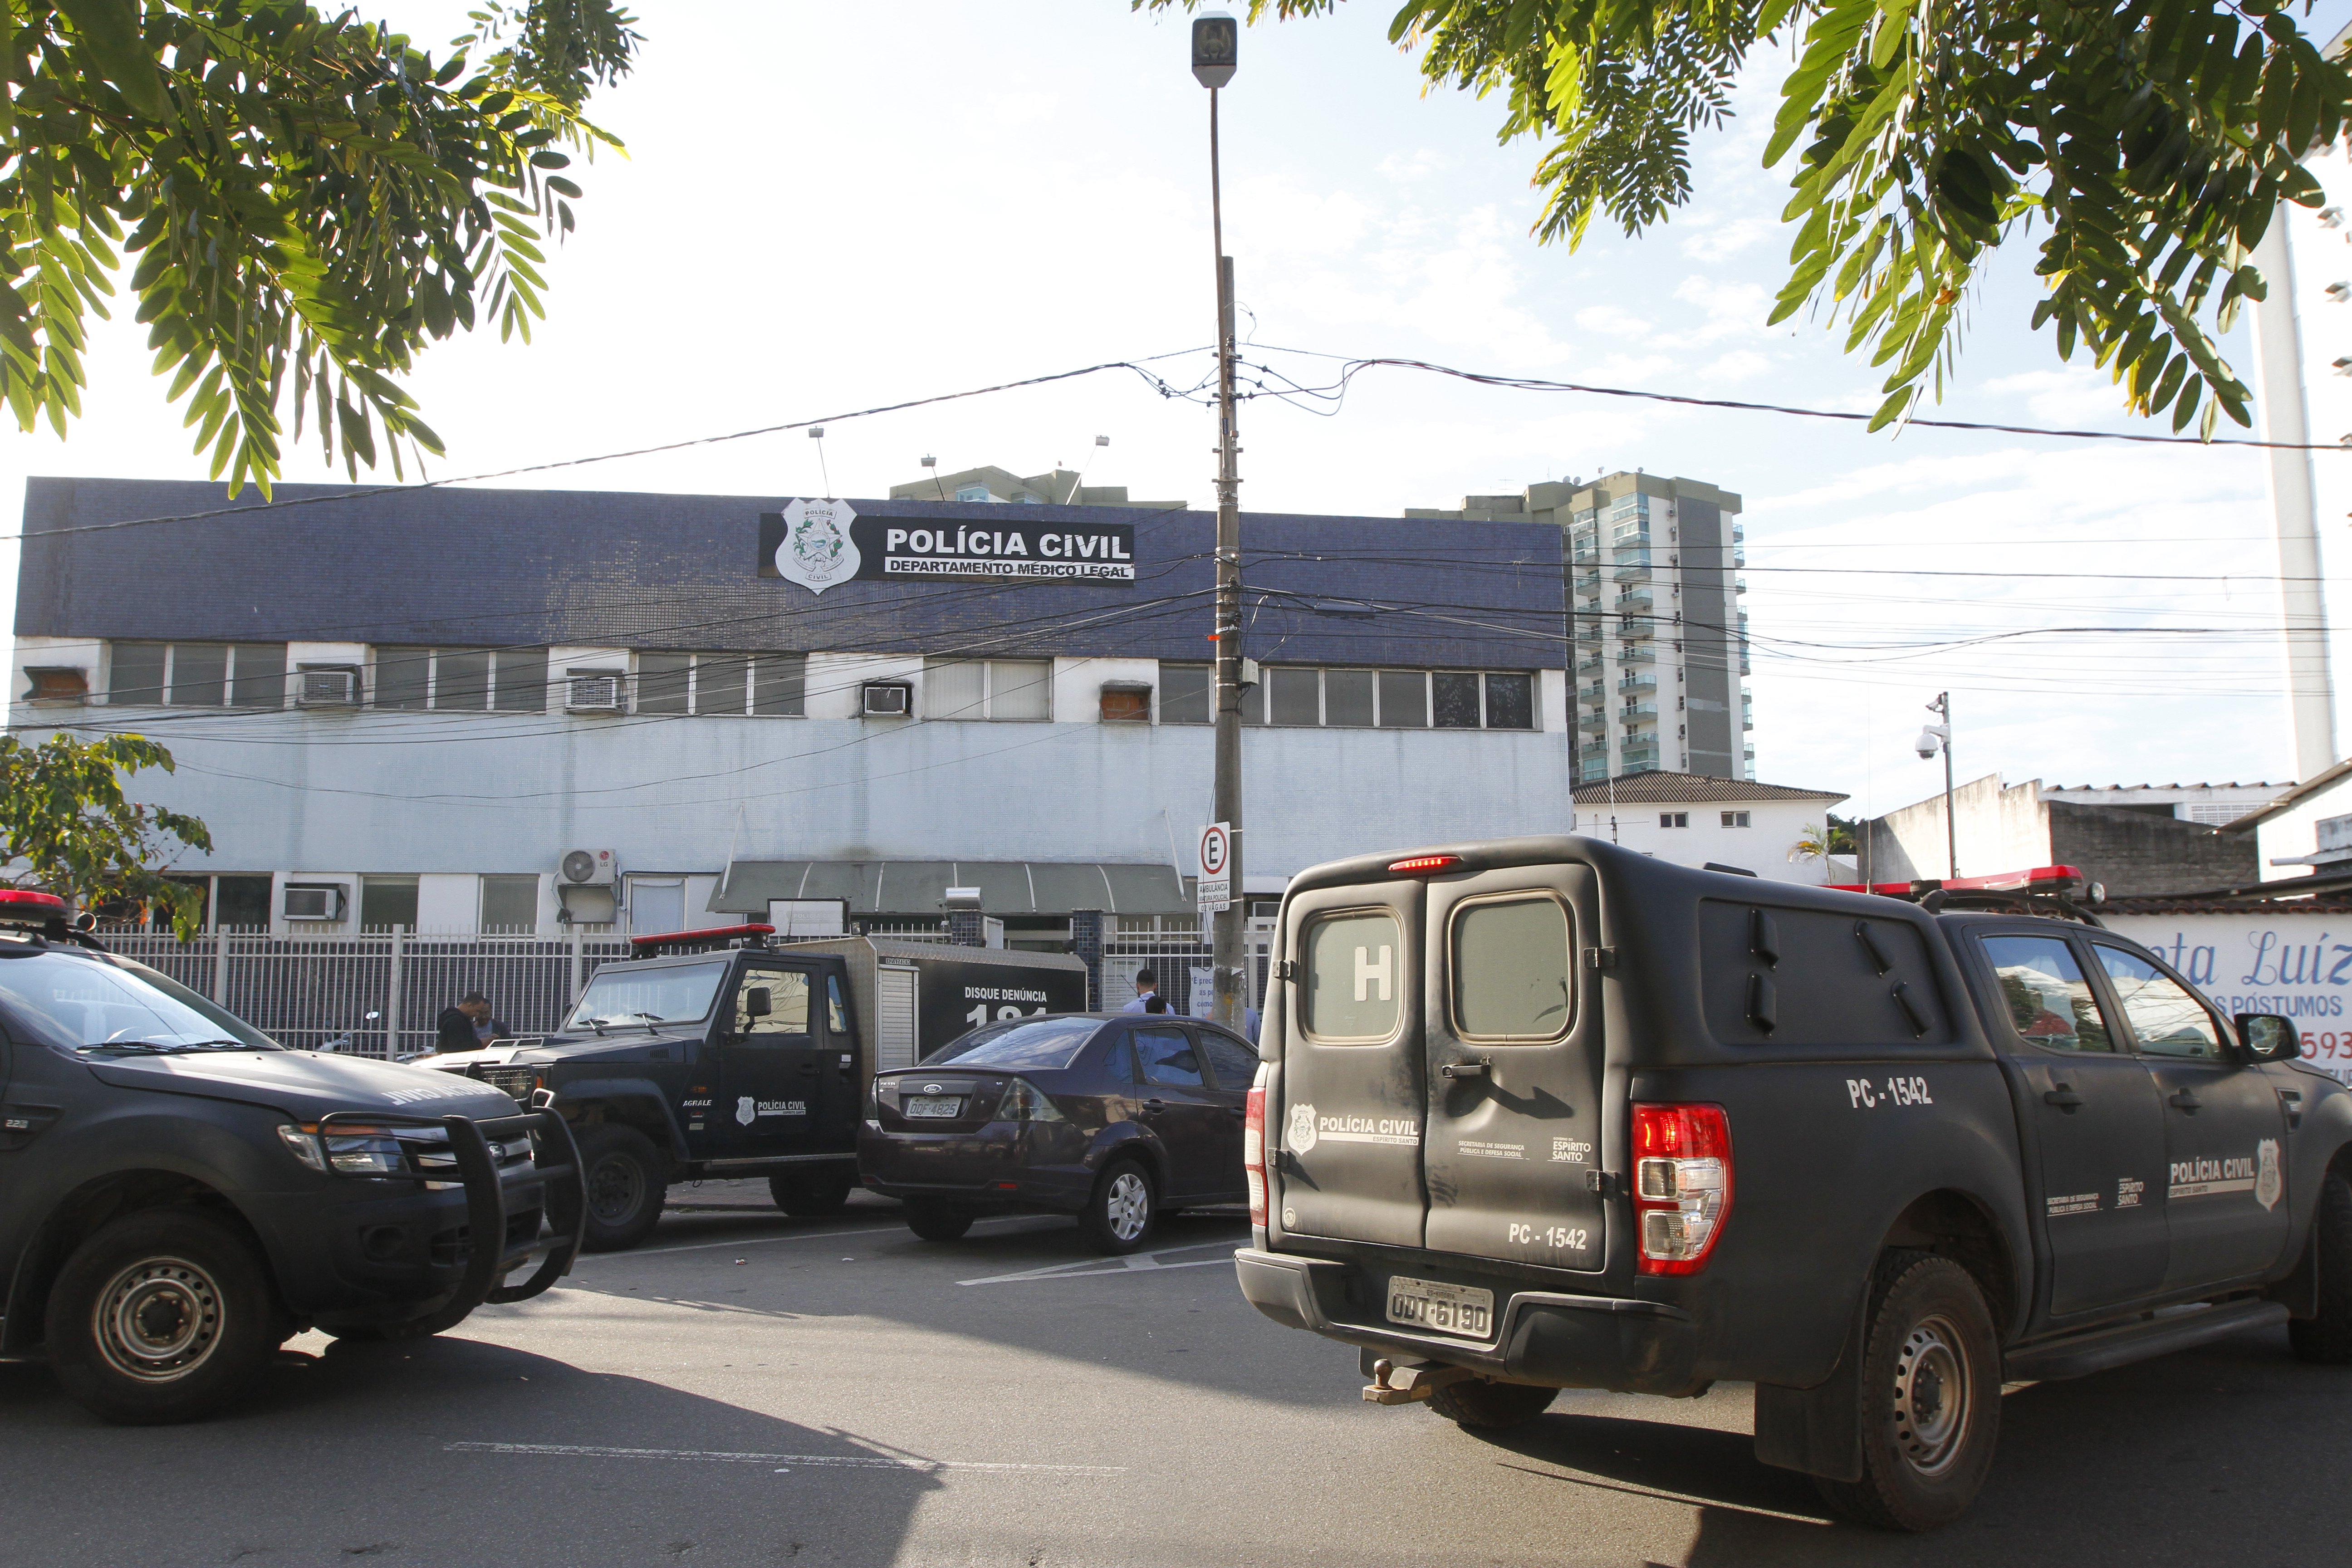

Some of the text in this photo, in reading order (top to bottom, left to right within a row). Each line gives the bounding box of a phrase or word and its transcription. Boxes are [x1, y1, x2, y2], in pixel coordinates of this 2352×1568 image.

[887, 525, 1130, 559] POLÍCIA CIVIL
[890, 560, 1013, 574] DEPARTAMENTO
[1209, 836, 1218, 864] E
[1199, 882, 1228, 893] AMBULÂNCIA
[1354, 945, 1392, 1001] H
[965, 986, 1047, 1002] DISQUE DENÚNCIA
[2232, 992, 2343, 1018] PÓSTUMOS
[1846, 1078, 1876, 1108] PC
[1887, 1076, 1933, 1106] 1542
[758, 1099, 806, 1111] POLÍCIA CIVIL
[1319, 1114, 1418, 1136] POLÍCIA CIVIL
[1552, 1151, 1583, 1161] SANTO
[1553, 1141, 1591, 1152] ESPÍRITO
[2170, 1156, 2255, 1184] POLÍCIA CIVIL
[2118, 1193, 2138, 1205] SANTO
[1509, 1223, 1531, 1244] PC
[1546, 1226, 1587, 1250] 1542
